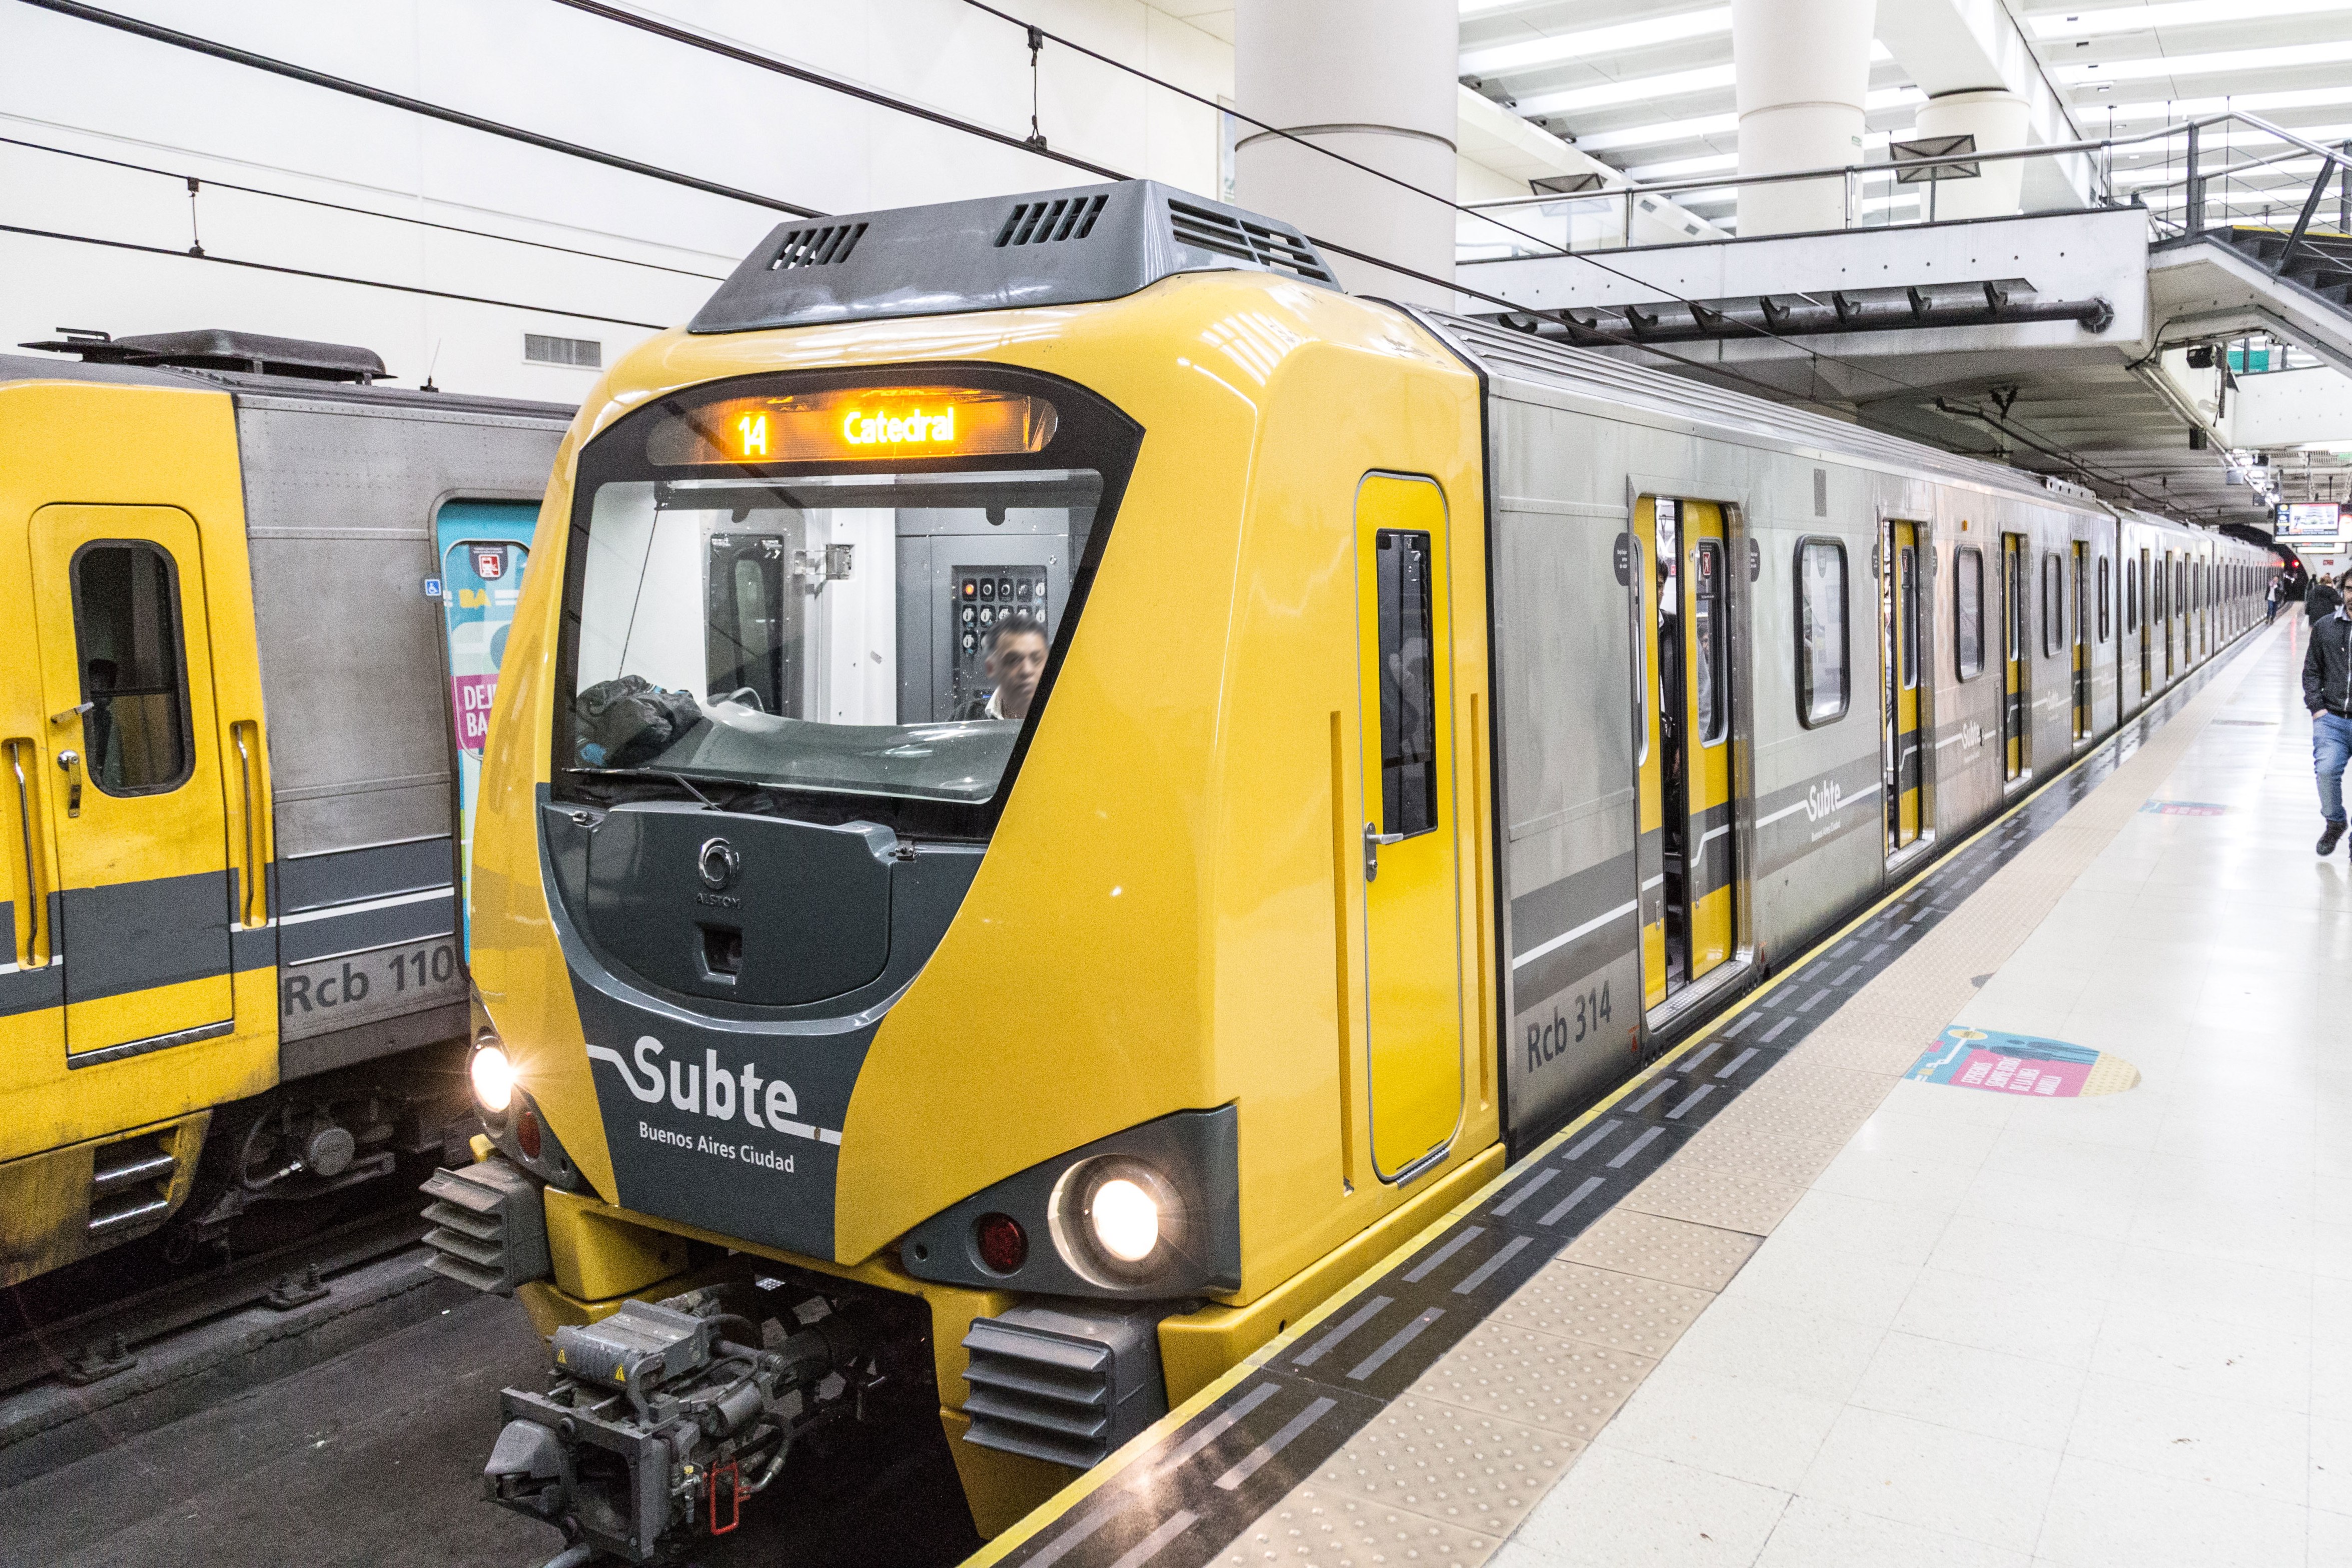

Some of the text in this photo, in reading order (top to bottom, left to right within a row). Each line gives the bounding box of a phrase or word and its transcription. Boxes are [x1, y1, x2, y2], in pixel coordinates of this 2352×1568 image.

[738, 406, 954, 455] 14 Catedral
[1808, 780, 1841, 822] Subte
[284, 945, 454, 1016] Rcb 110
[1527, 980, 1612, 1073] Rcb 314
[633, 1035, 801, 1135] Subte
[639, 1121, 795, 1173] Buenos Aires Ciudad
